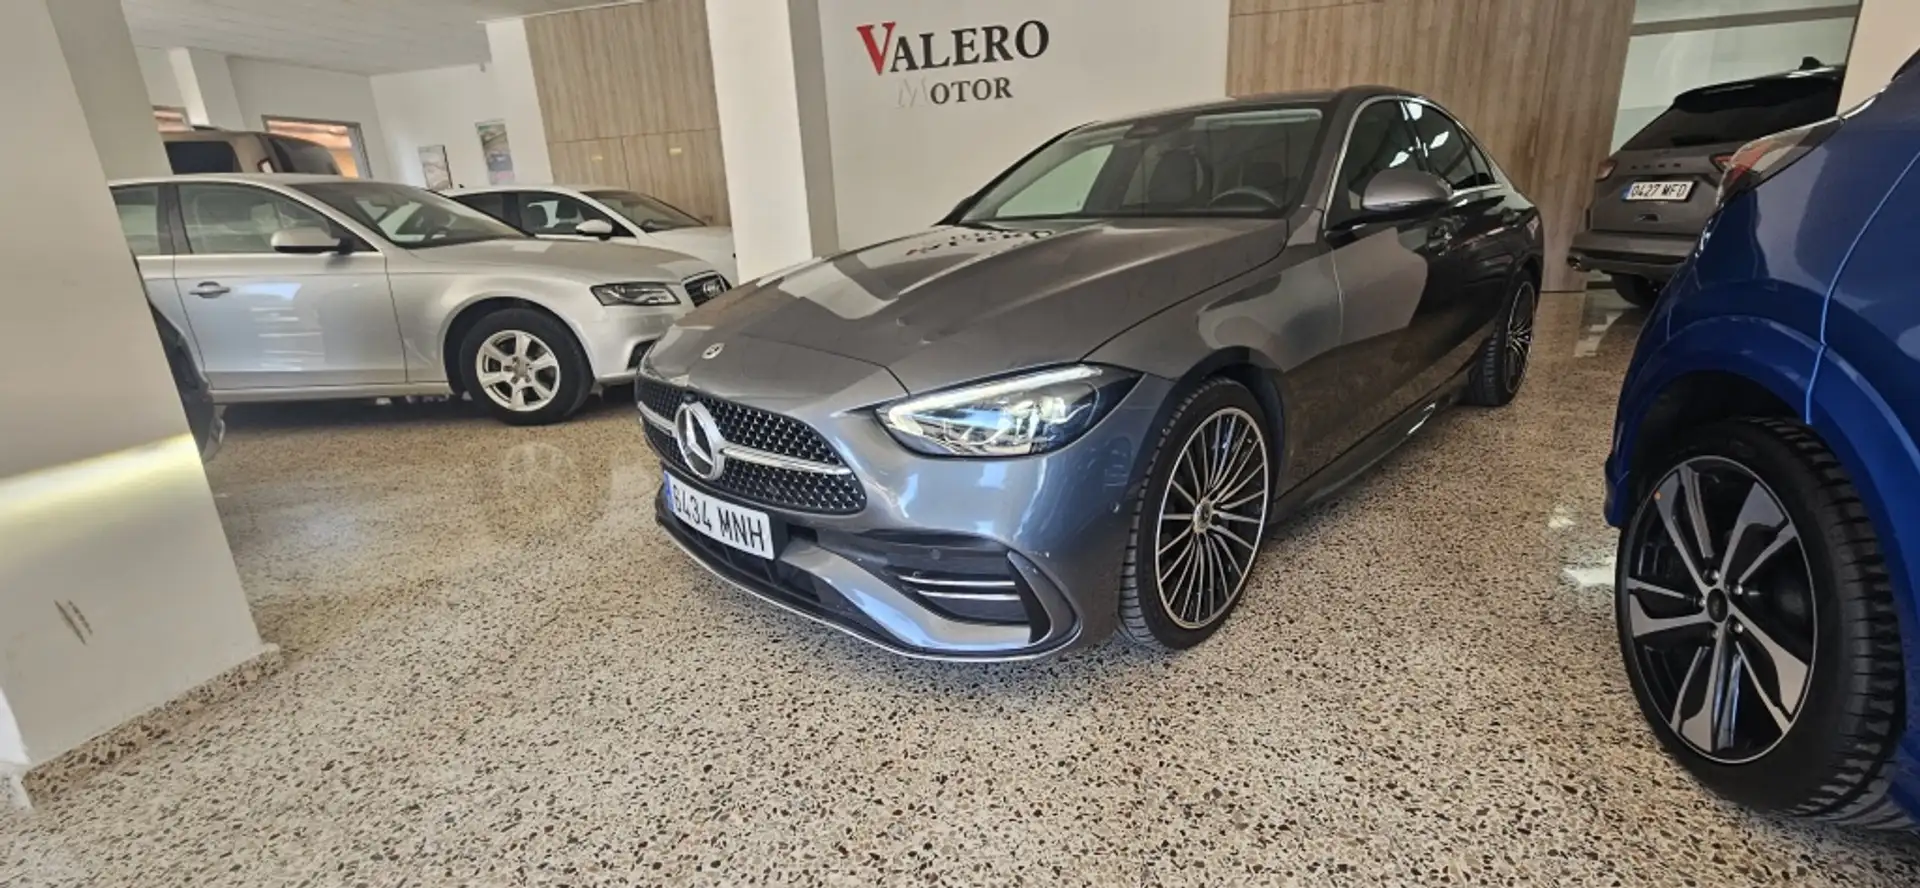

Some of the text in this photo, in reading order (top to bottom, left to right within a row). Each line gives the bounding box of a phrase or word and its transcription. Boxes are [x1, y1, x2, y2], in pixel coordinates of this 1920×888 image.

[857, 20, 1049, 75] VALERO
[1631, 183, 1661, 197] 0427
[673, 484, 765, 552] 6434 MNH
